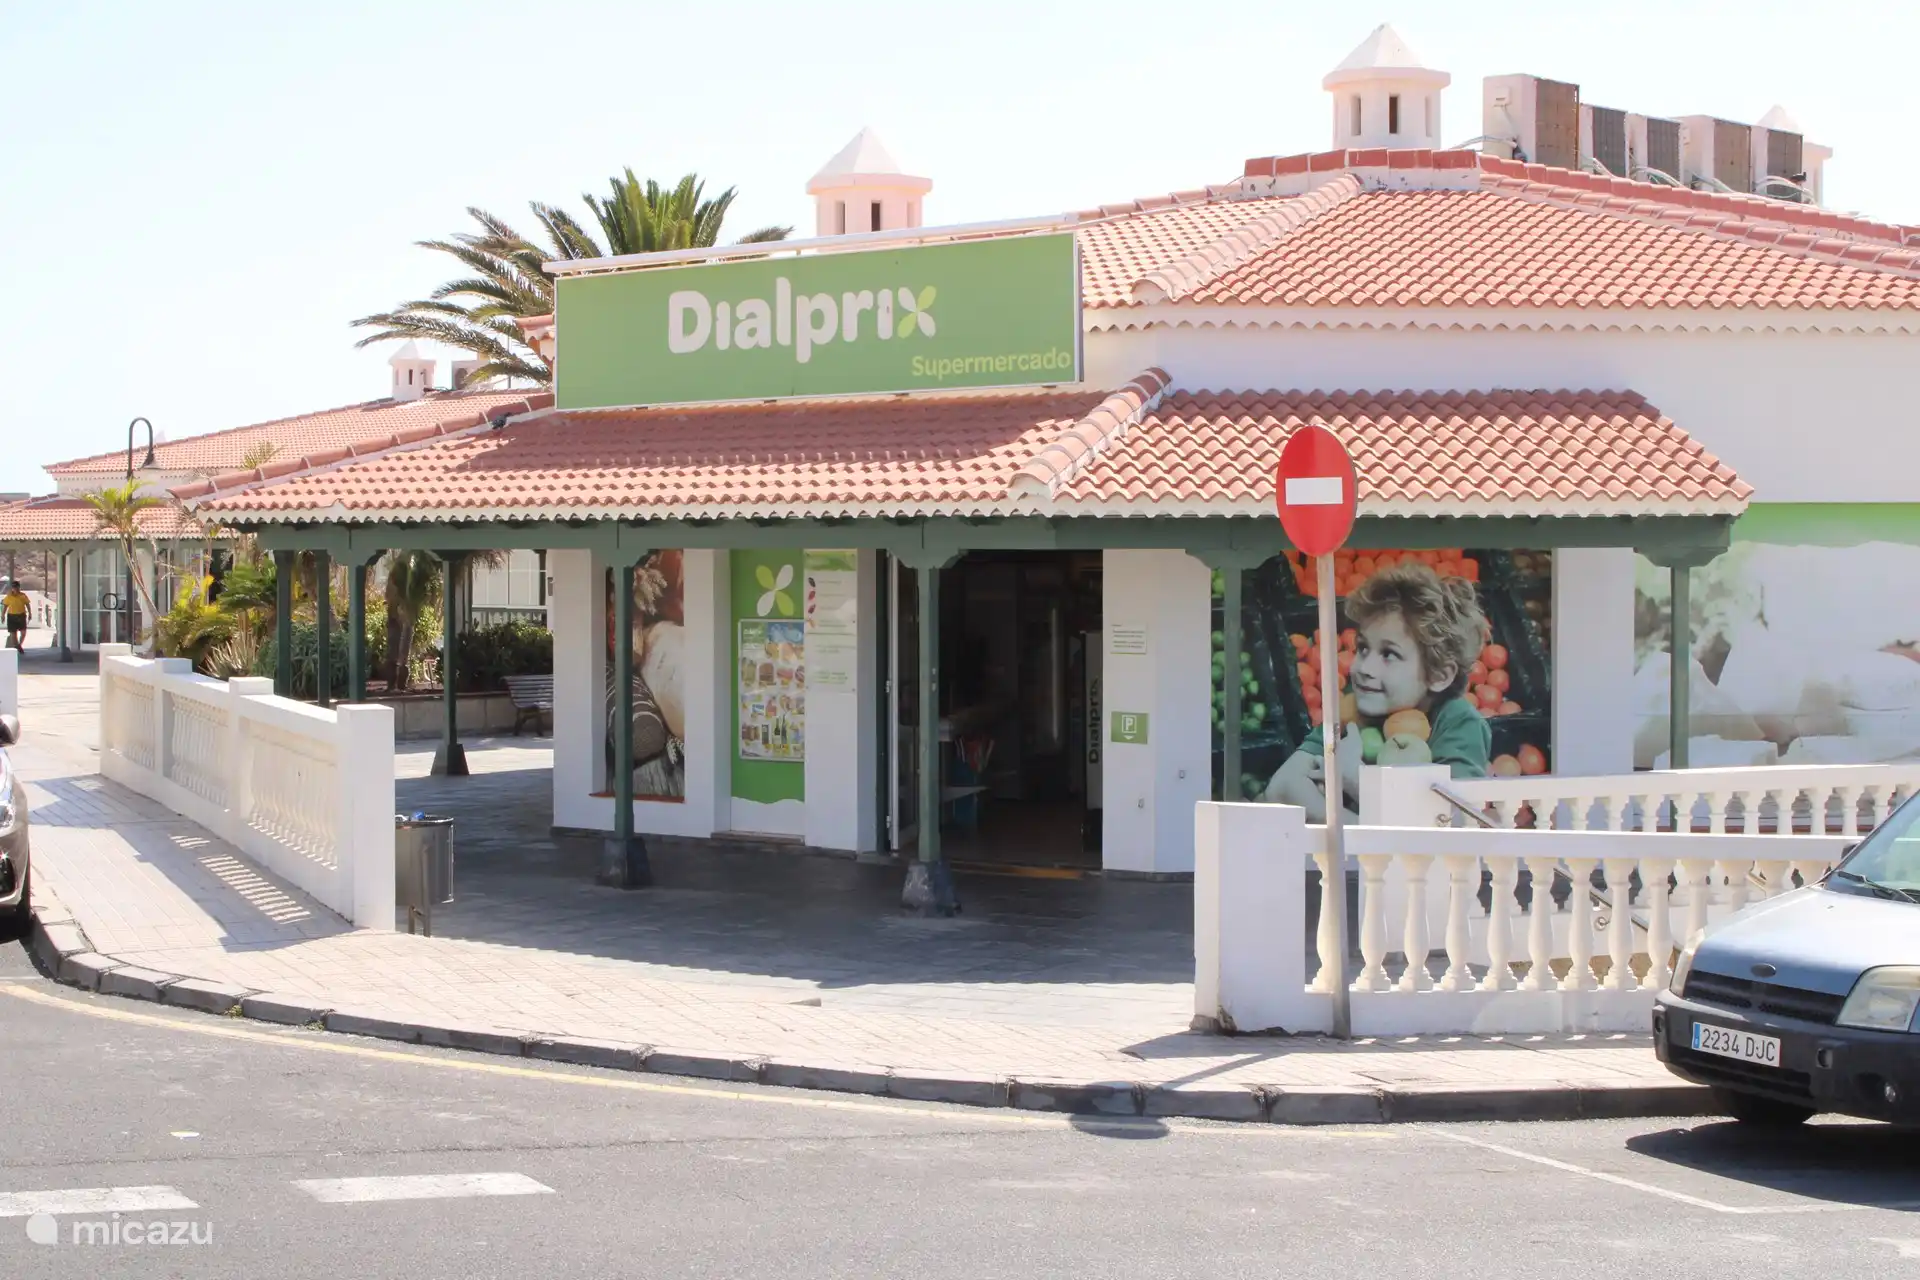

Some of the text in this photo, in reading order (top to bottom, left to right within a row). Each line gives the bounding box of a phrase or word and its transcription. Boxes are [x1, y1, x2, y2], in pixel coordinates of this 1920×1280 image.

[668, 276, 936, 363] Dialprix
[911, 347, 1072, 378] Supermercado
[1702, 1028, 1776, 1062] 2234 DJC
